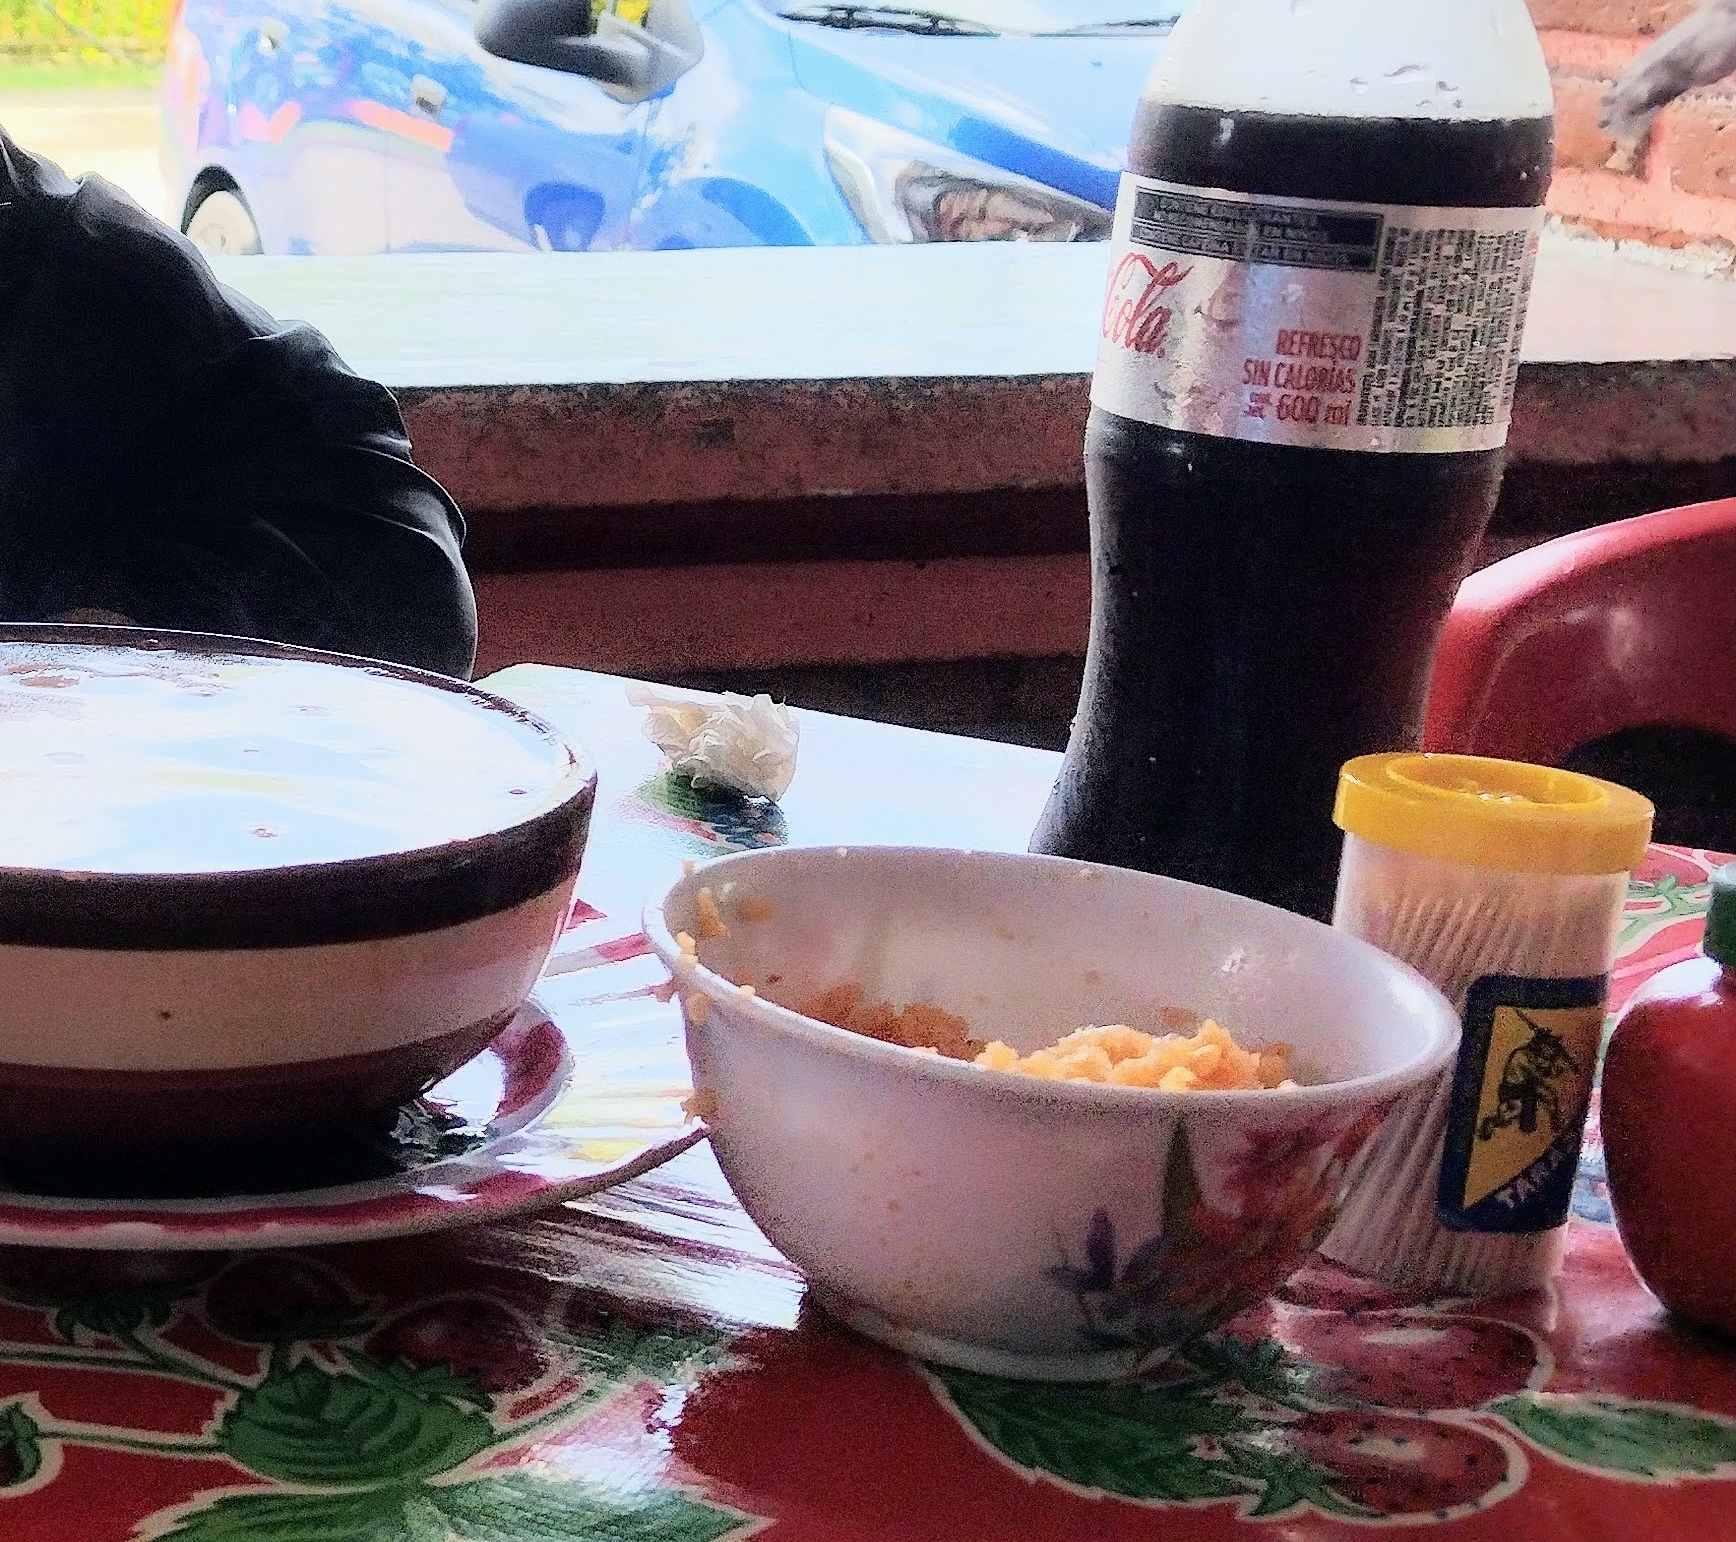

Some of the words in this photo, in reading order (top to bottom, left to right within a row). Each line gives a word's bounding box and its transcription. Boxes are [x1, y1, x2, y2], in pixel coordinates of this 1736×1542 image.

[1275, 328, 1362, 361] REFRESCO
[1242, 358, 1271, 388] SIN
[1276, 393, 1321, 424] 600
